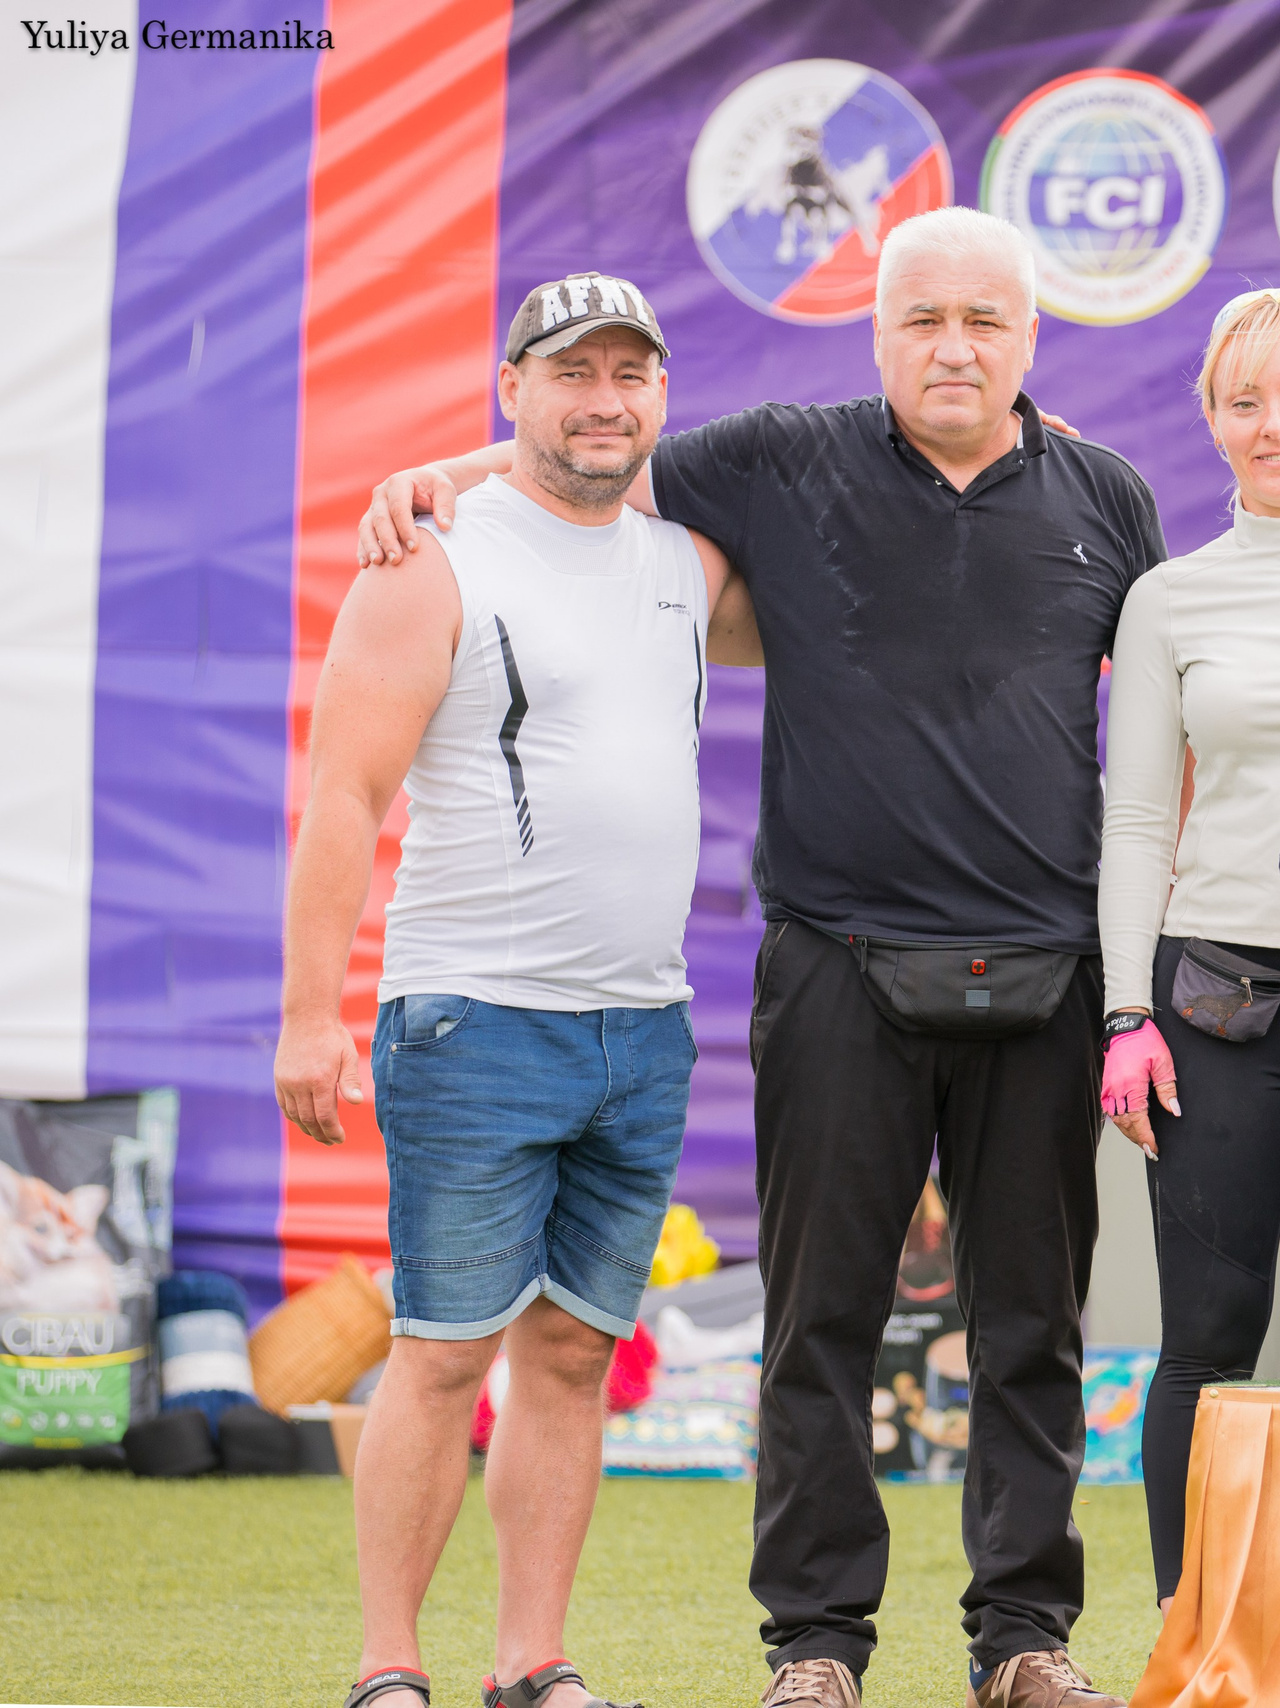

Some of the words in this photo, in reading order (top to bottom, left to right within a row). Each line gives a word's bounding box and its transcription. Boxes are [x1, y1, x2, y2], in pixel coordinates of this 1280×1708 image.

[1045, 176, 1167, 230] FCI
[541, 276, 652, 332] AFNY
[16, 1369, 103, 1396] PUPPY
[367, 1673, 401, 1688] HEAD
